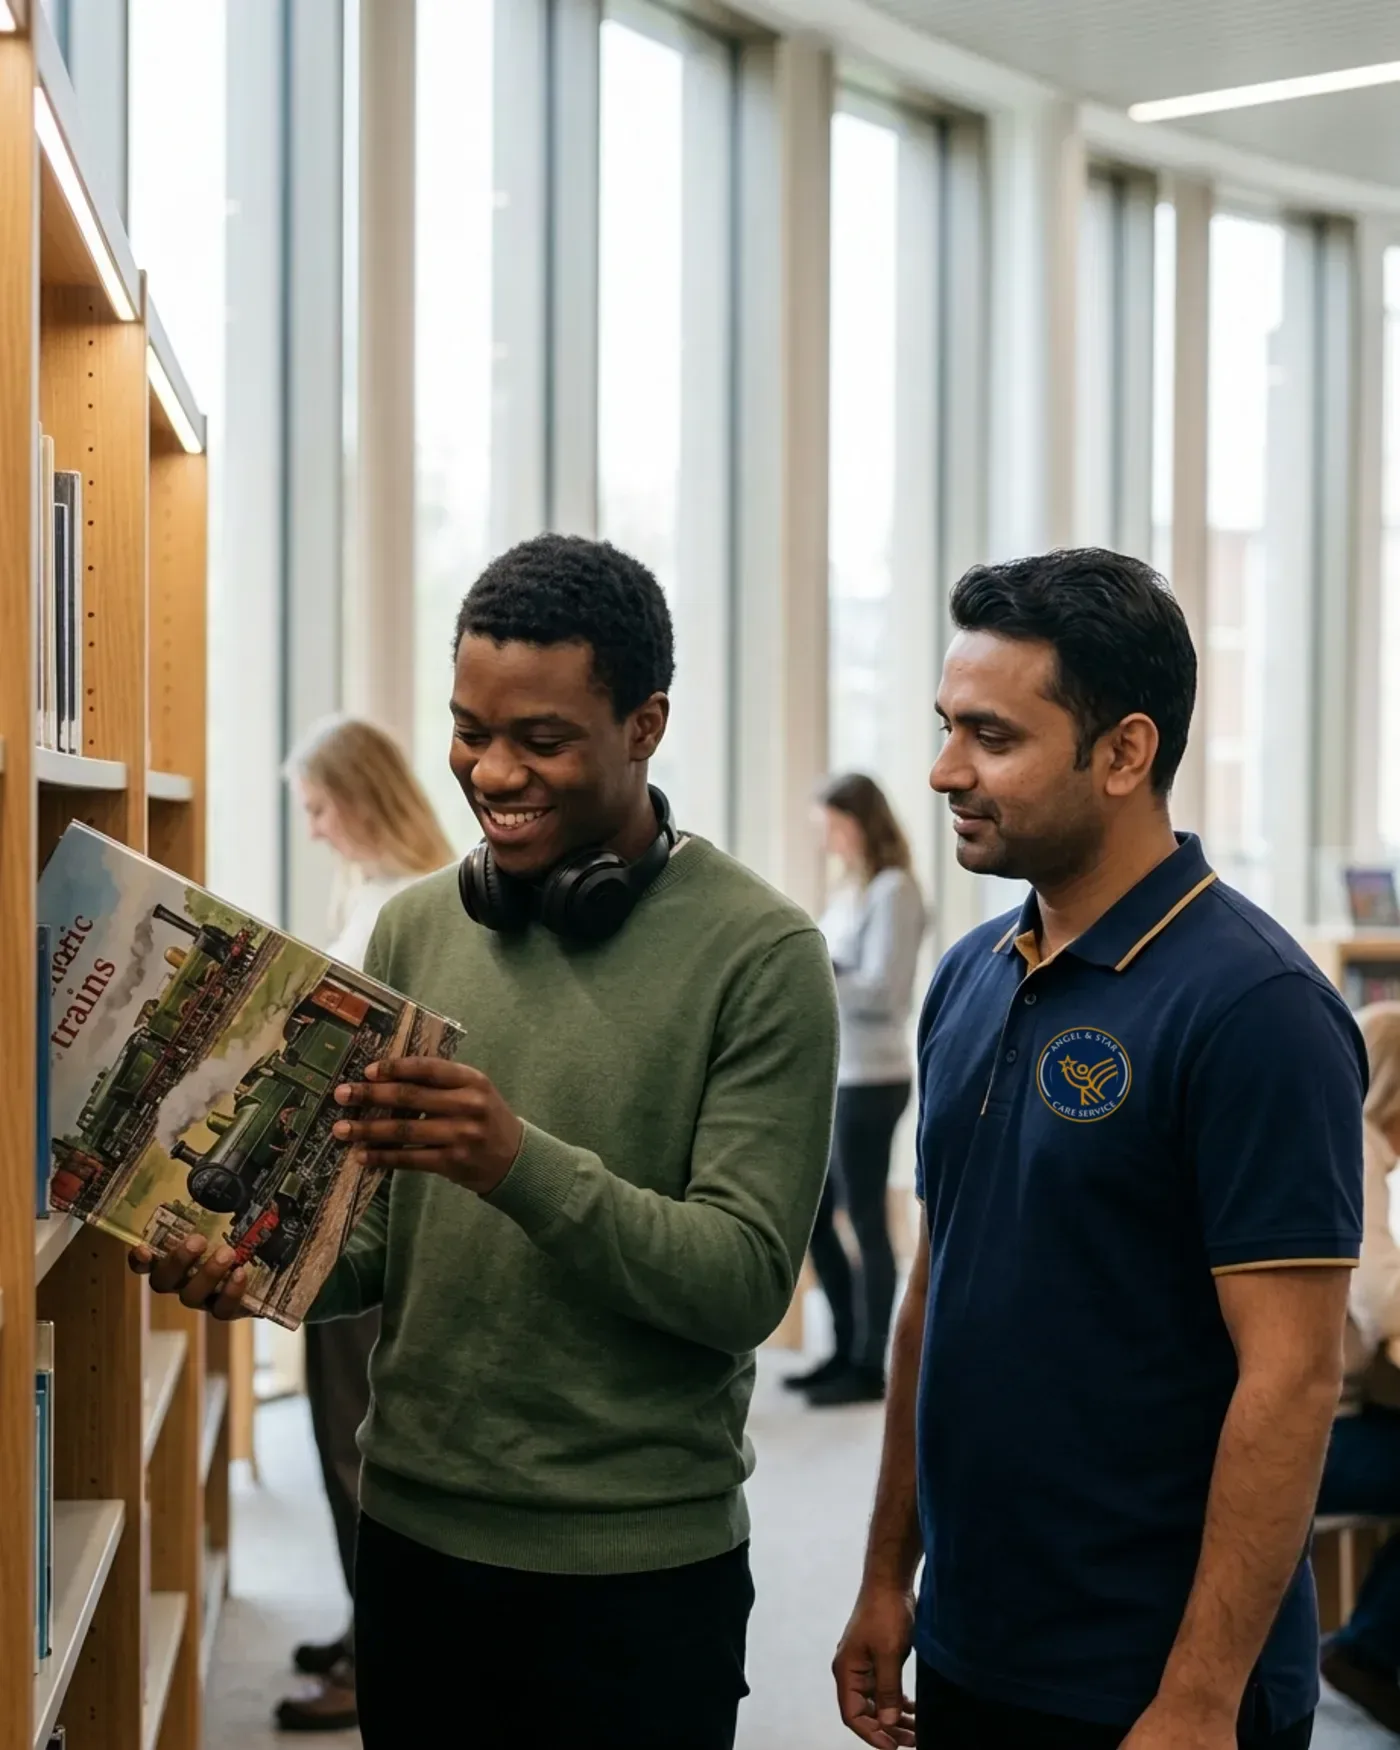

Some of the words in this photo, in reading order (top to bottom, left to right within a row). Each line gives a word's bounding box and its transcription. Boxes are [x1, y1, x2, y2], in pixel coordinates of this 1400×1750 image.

[51, 958, 115, 1049] trains
[1050, 1032, 1081, 1052] ANGEL
[1084, 1031, 1092, 1039] &
[1095, 1034, 1118, 1052] STAR
[1052, 1101, 1076, 1116] CARE
[1078, 1100, 1116, 1117] SERVICE
